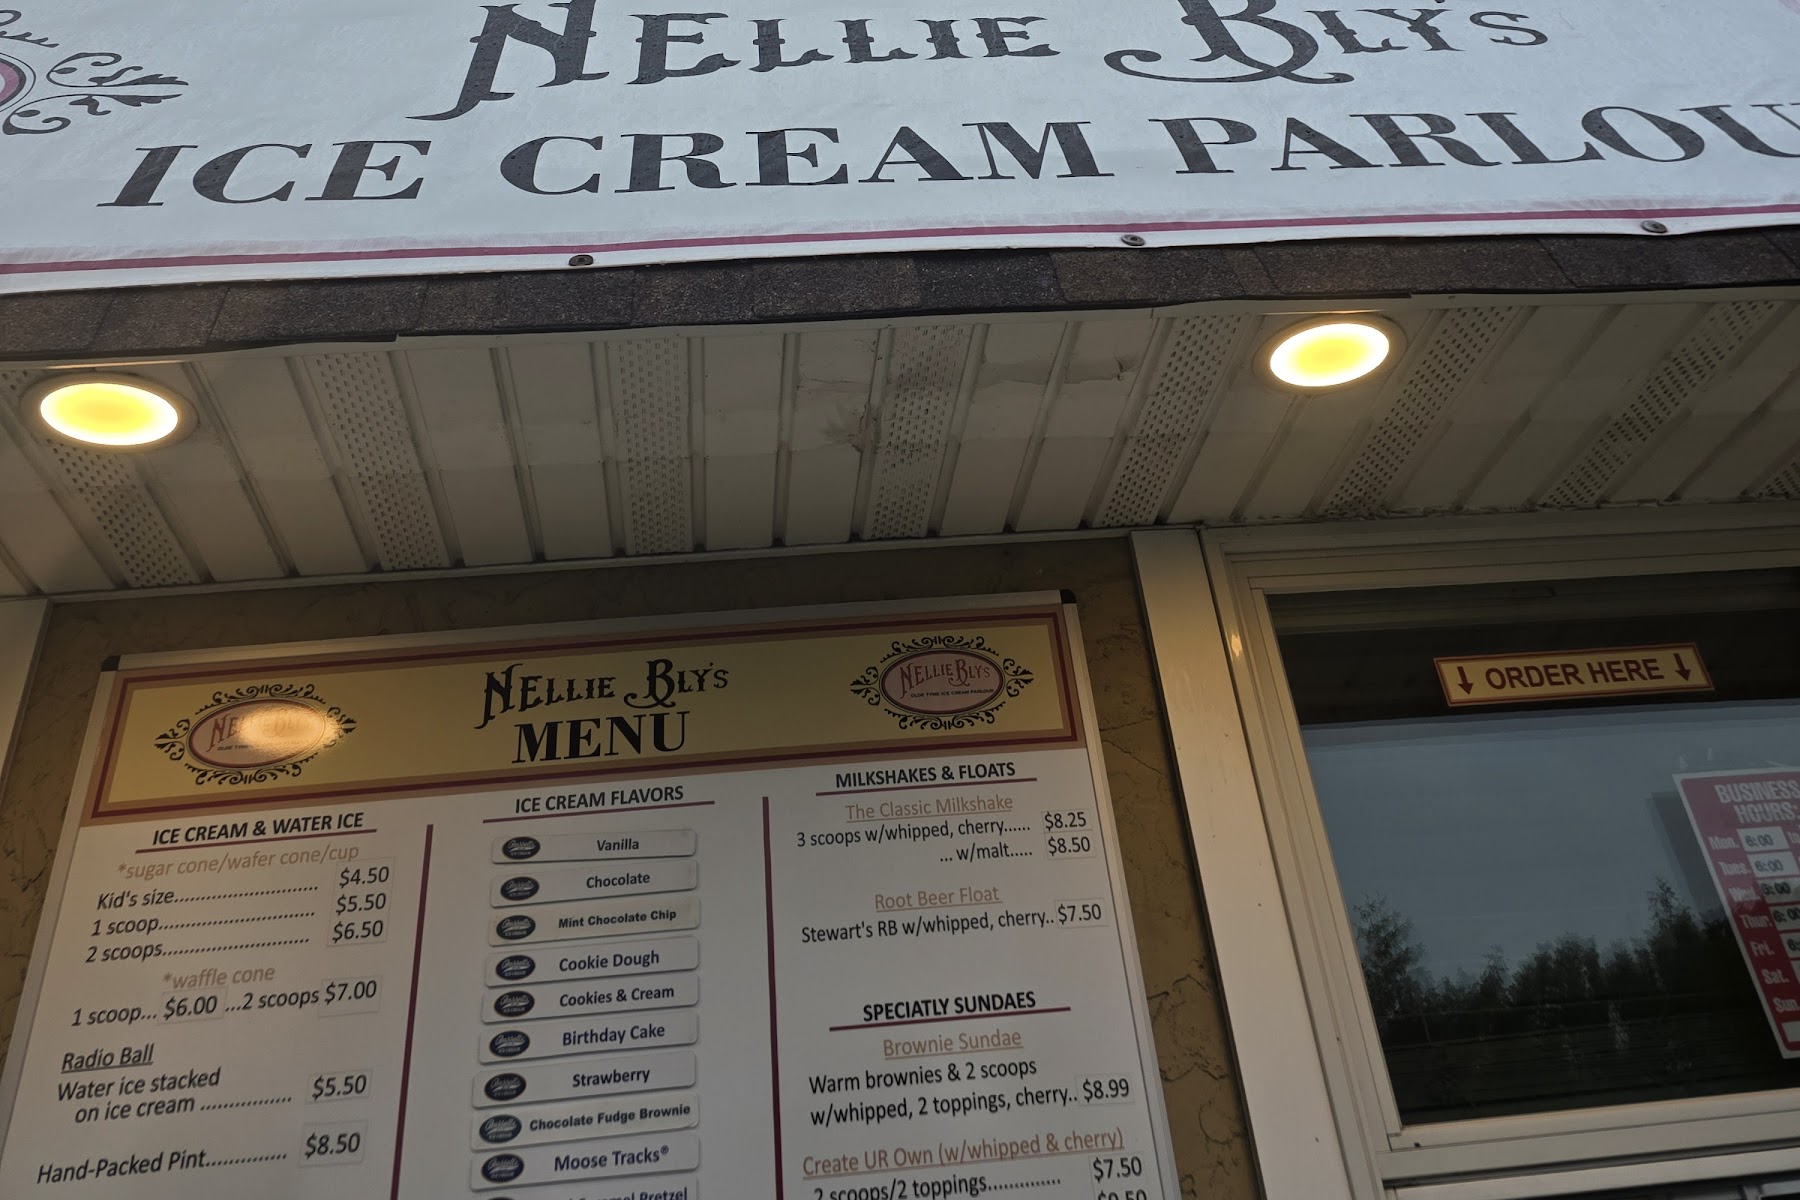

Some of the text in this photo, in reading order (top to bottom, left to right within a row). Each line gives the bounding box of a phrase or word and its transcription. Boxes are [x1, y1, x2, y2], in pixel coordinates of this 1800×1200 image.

[97, 103, 1800, 207] ICE CREAM PARLOU
[899, 658, 991, 699] NELLIE BLY'S
[1485, 658, 1664, 689] ORDER HERE
[474, 658, 729, 730] NELLIE BLY'S
[512, 711, 690, 763] MENU
[835, 761, 1016, 788] MILKSHAKES & FLOATS
[515, 785, 684, 814] ICE CREAM FLAVORS
[846, 793, 1014, 820] The Classic Milkshake
[1713, 779, 1800, 804] BUSINESS
[153, 812, 364, 846] ICE CREAM & WATER ICE
[796, 831, 806, 848] 3
[810, 827, 861, 847] scoops
[865, 820, 954, 844] w/whipped,
[1044, 811, 1087, 831] $8.25
[177, 850, 273, 875] cone/wafer
[280, 843, 360, 867] cone/cup
[597, 837, 640, 853] Vanilla
[1047, 835, 1091, 856] $8.50
[97, 890, 138, 911] Kid's
[339, 866, 390, 889] $4.50
[586, 873, 650, 890] Chocolate
[874, 886, 1000, 910] Root Beer Float
[91, 919, 101, 937] 1
[335, 893, 387, 916] $5.50
[558, 909, 677, 929] Mint Chocolate Chip
[802, 922, 873, 944] Stewart's
[877, 920, 898, 938] RB
[902, 912, 994, 936] w/whipped,
[1057, 903, 1102, 924] $7.50
[85, 946, 97, 964] 2
[332, 920, 384, 944] $6.50
[232, 965, 276, 984] cone
[559, 950, 660, 972] Cookie Dough
[71, 1008, 82, 1026] 1
[163, 995, 218, 1021] $6.00
[258, 987, 319, 1008] scoops
[324, 980, 378, 1005] $7.00
[559, 986, 675, 1008] Cookies & Cream
[862, 990, 1036, 1022] SPECIATLY SUNDAES
[562, 1023, 665, 1048] Birthday Cake
[883, 1027, 1022, 1057] Brownie Sundae
[61, 1043, 155, 1072] Radio Ball
[57, 1066, 221, 1101] Water ice stacked
[572, 1067, 651, 1088] Strawberry
[808, 1057, 1037, 1095] Warm brownies & 2 scoops
[75, 1074, 367, 1123] on ice cream $5.50
[810, 1097, 914, 1128] w/whipped,
[918, 1096, 929, 1115] 2
[932, 1091, 1012, 1115] toppings,
[1082, 1078, 1130, 1102] $8.99
[529, 1103, 691, 1132] Chocolate Fudge Brownie
[36, 1153, 162, 1185] Hand-Packed
[304, 1132, 361, 1158] $8.50
[553, 1153, 608, 1171] Moose
[802, 1125, 1124, 1176] Create UR Own (w/whipped & cherry)
[1092, 1156, 1142, 1184] $7.50
